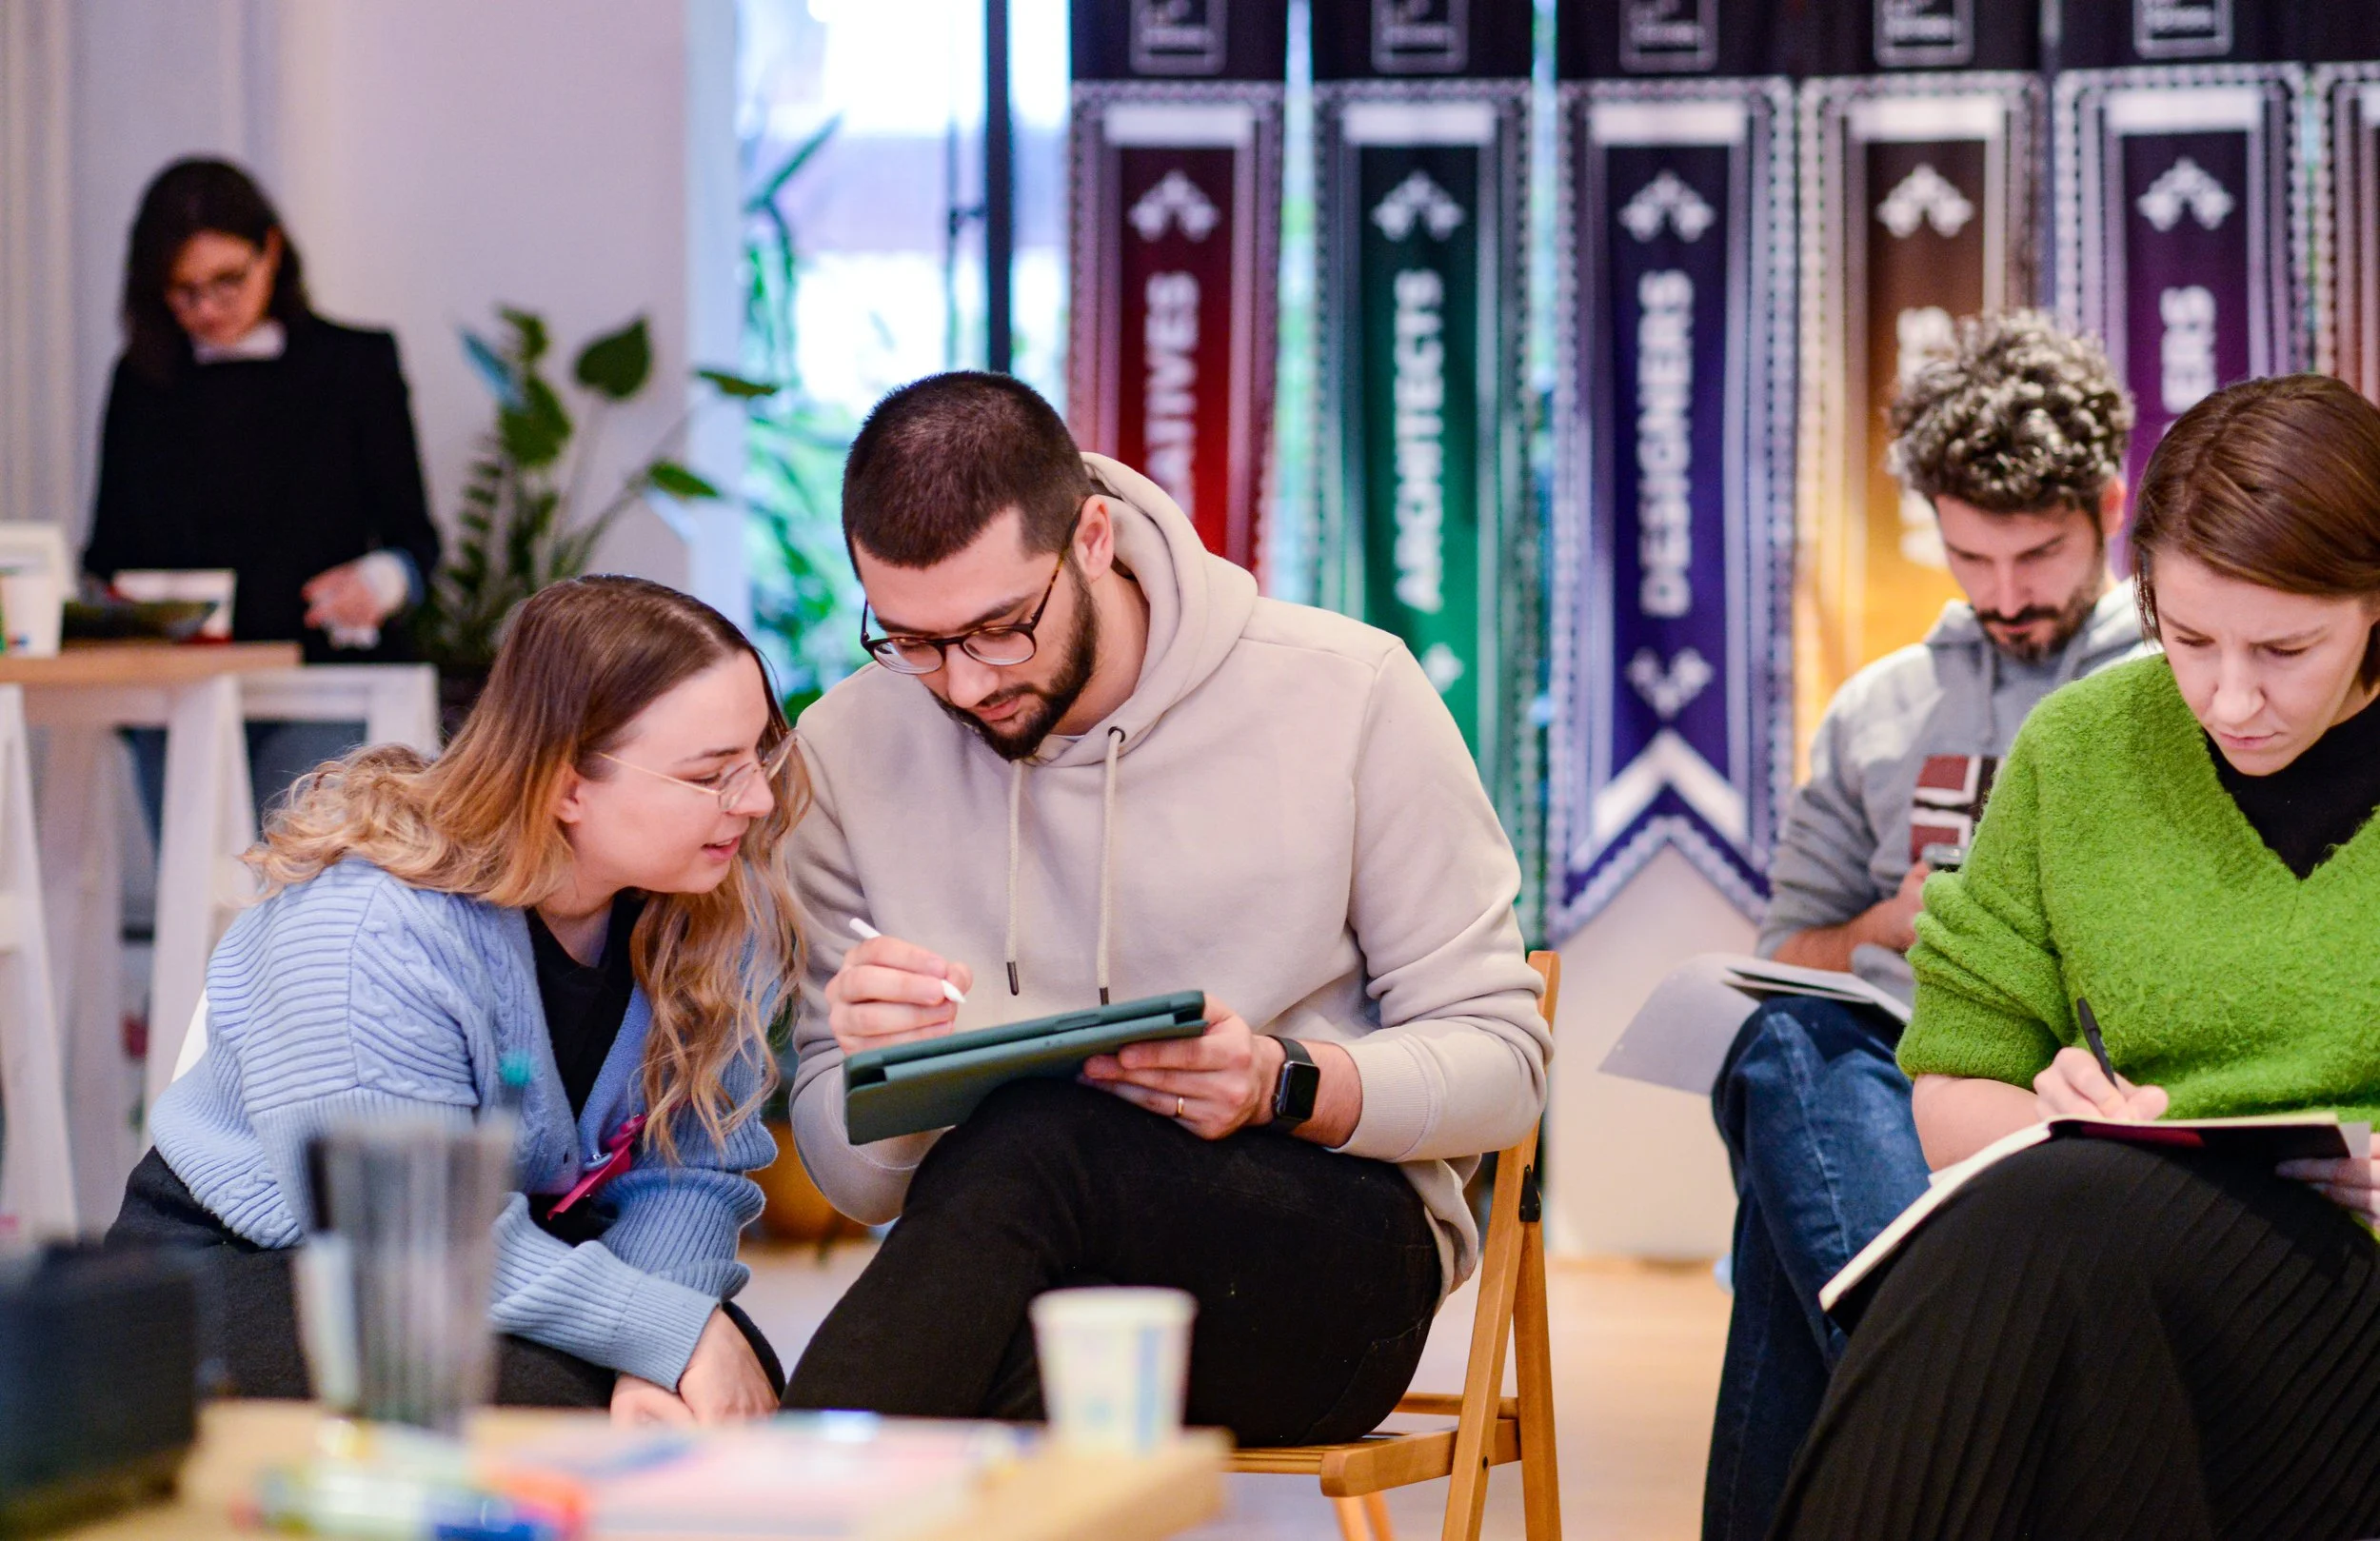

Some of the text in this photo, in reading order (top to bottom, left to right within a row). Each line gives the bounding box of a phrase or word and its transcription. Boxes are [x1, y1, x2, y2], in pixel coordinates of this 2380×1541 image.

[1144, 272, 1199, 520] ATIVES
[1393, 269, 1444, 614] ARCHITECTS
[1636, 270, 1695, 618] DESIGNERS
